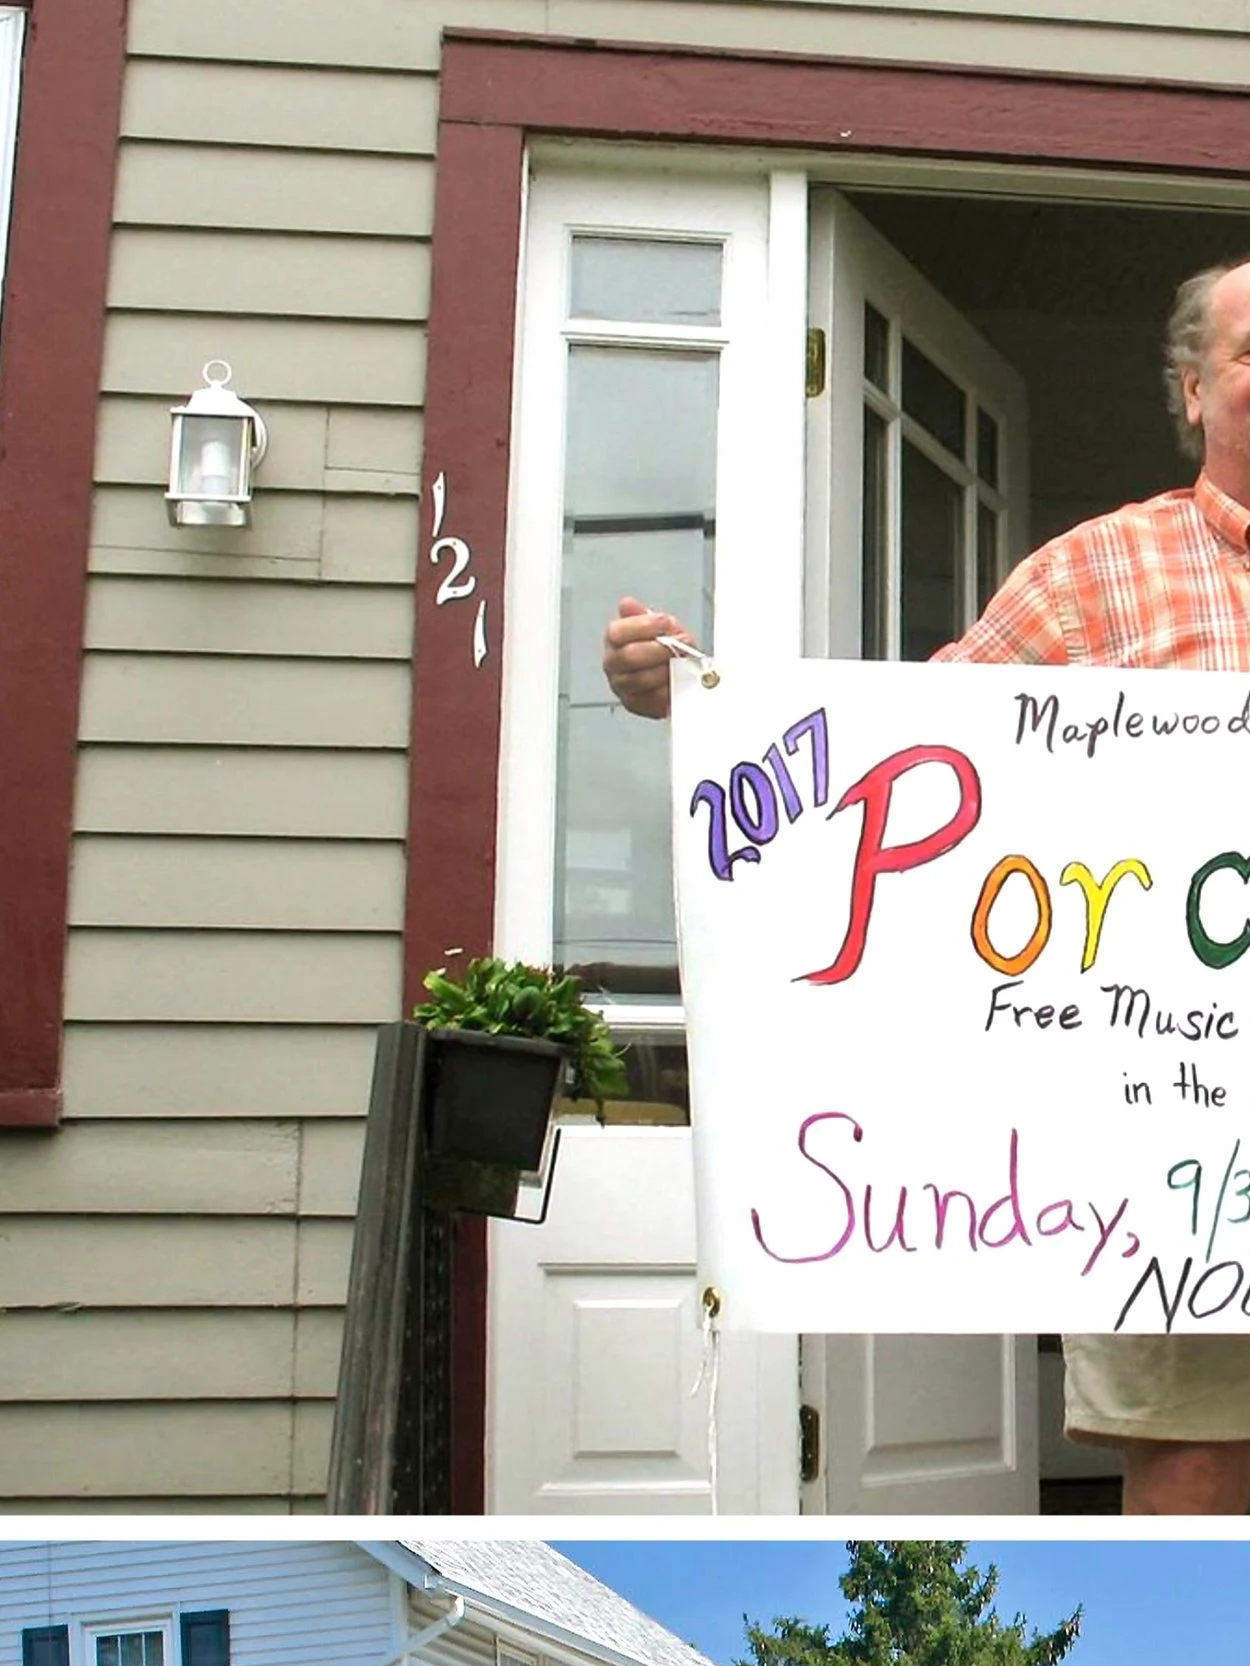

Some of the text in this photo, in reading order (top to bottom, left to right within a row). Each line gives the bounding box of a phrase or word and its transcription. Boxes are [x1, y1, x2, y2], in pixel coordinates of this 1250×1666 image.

[429, 471, 488, 669] 121
[689, 707, 830, 882] 2017
[984, 980, 1083, 1032] Free
[1100, 984, 1239, 1042] Music
[1122, 1071, 1152, 1105] in
[1173, 1061, 1227, 1108] the
[751, 1111, 1141, 1276] Sunday,
